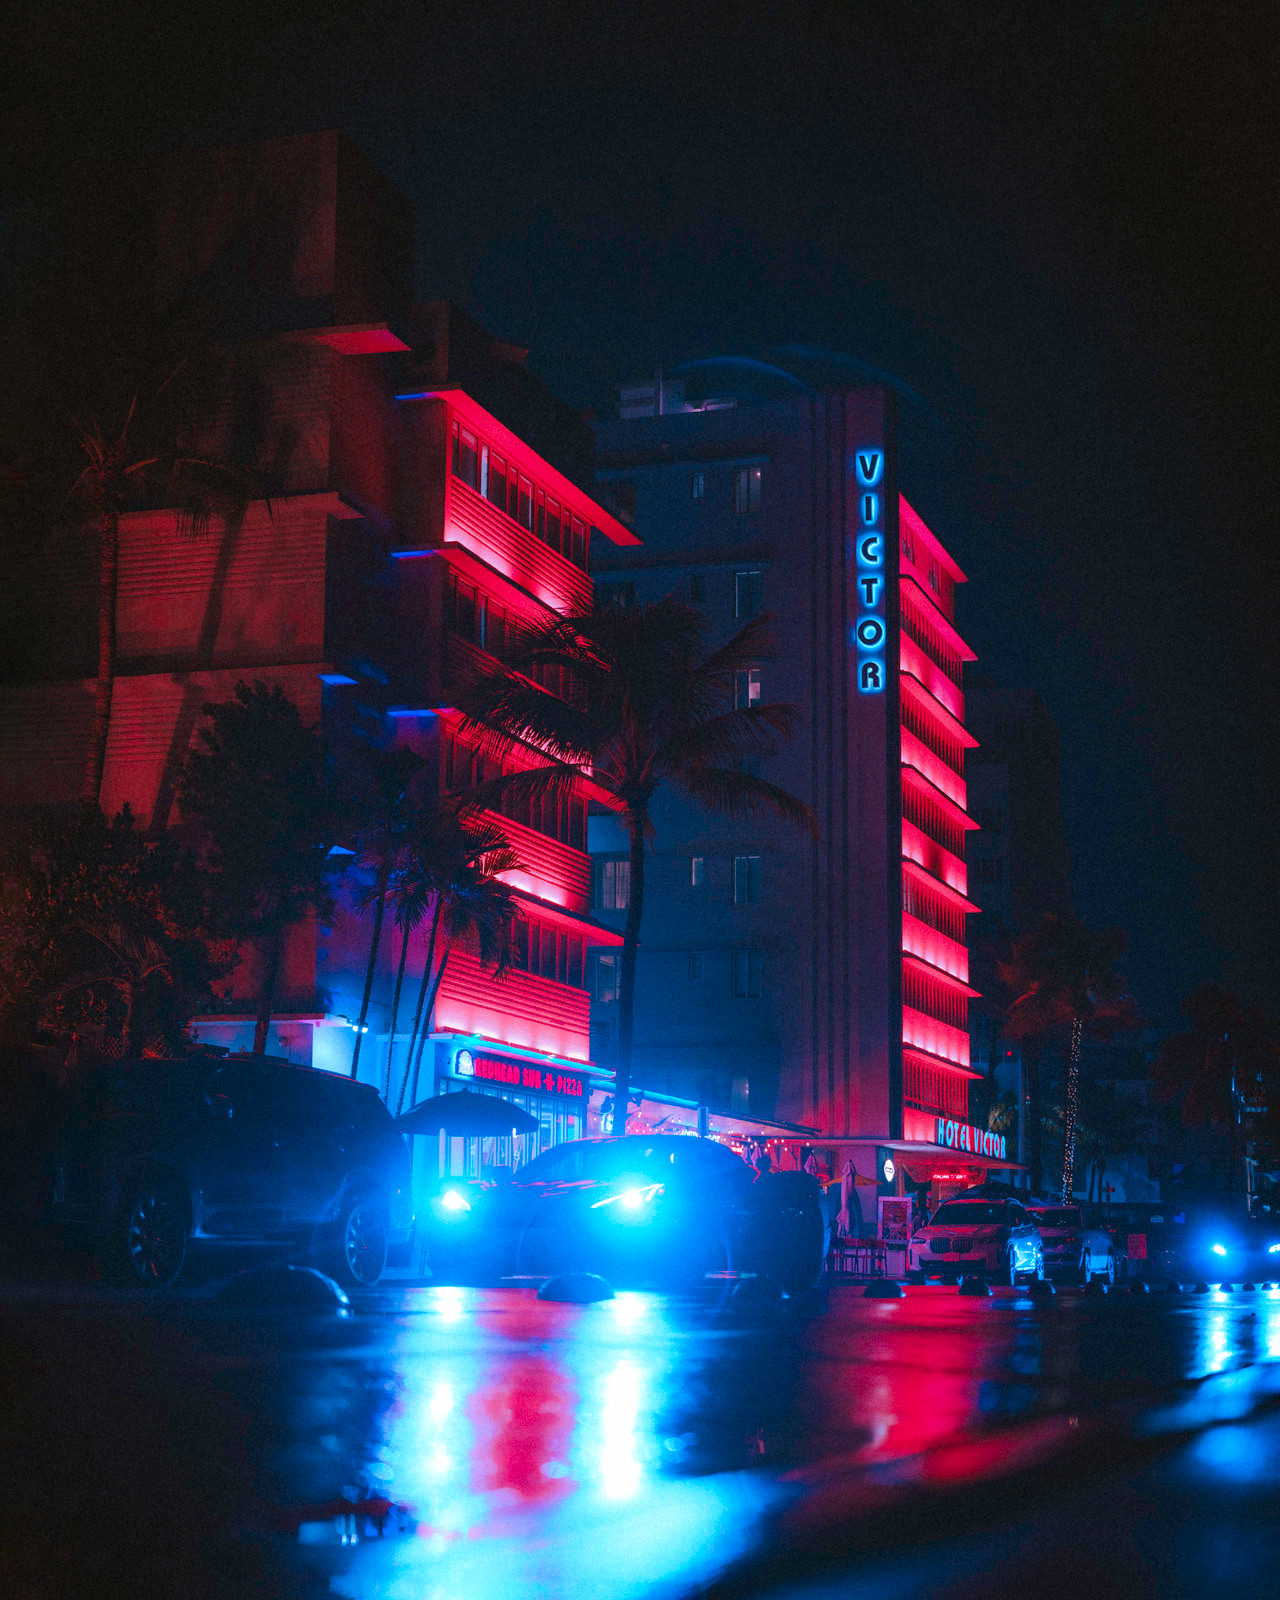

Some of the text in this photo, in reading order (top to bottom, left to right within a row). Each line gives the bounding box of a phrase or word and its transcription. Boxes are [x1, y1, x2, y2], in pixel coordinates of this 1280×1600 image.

[857, 454, 885, 690] VICTOR
[475, 1058, 520, 1085] REDHEAD
[523, 1068, 541, 1089] SUB
[557, 1075, 583, 1097] PIZZA
[938, 1118, 1006, 1159] HOTEL VICTOR
